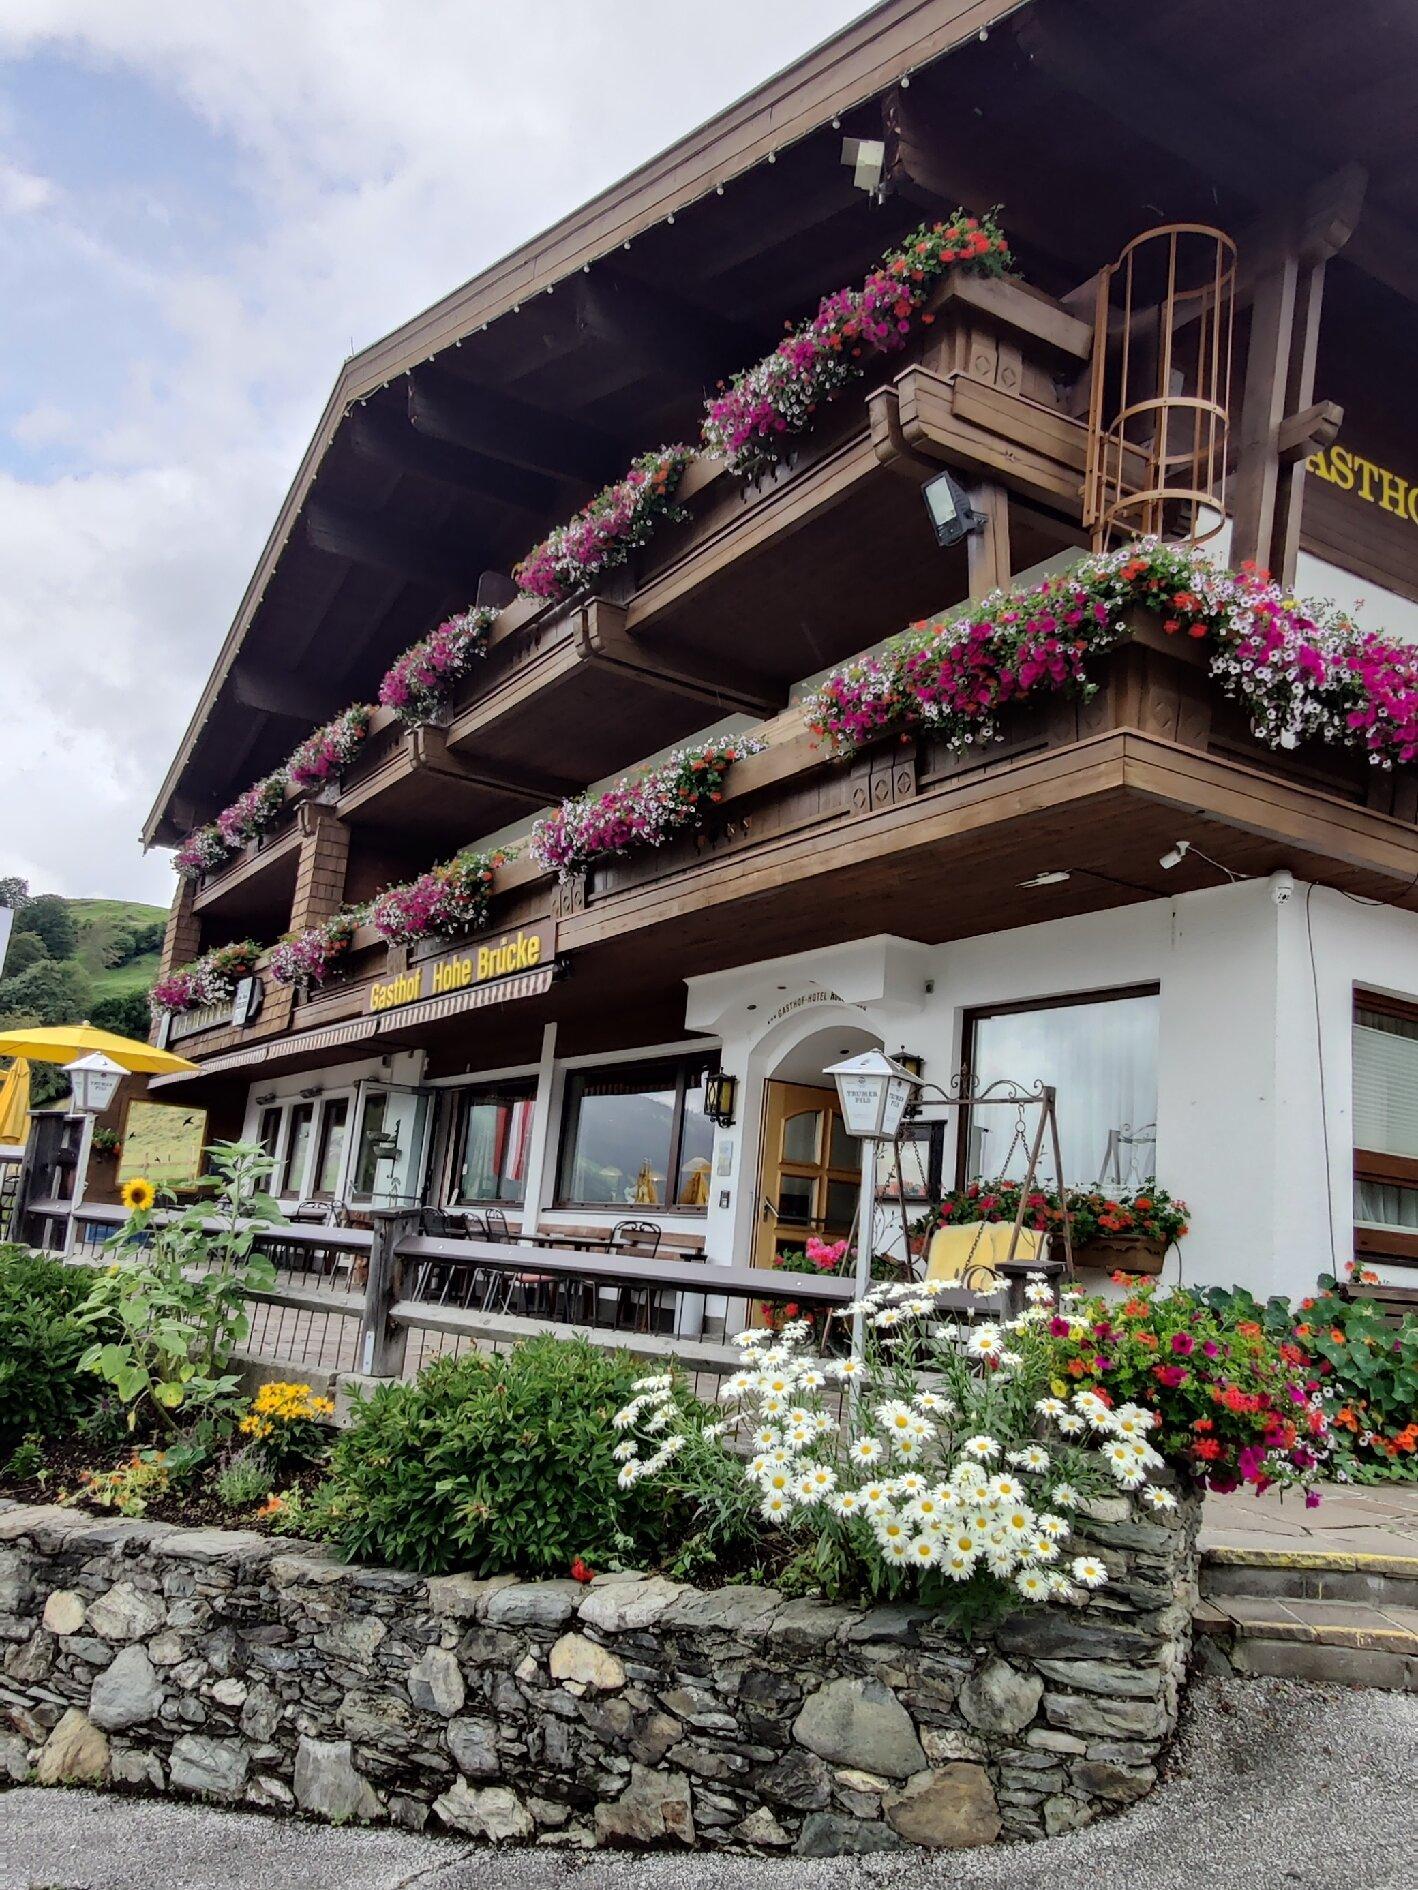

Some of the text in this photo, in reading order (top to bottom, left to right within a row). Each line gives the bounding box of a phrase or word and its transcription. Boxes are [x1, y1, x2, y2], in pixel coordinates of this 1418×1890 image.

[370, 931, 541, 1011] Gasthof Hohe Brücke
